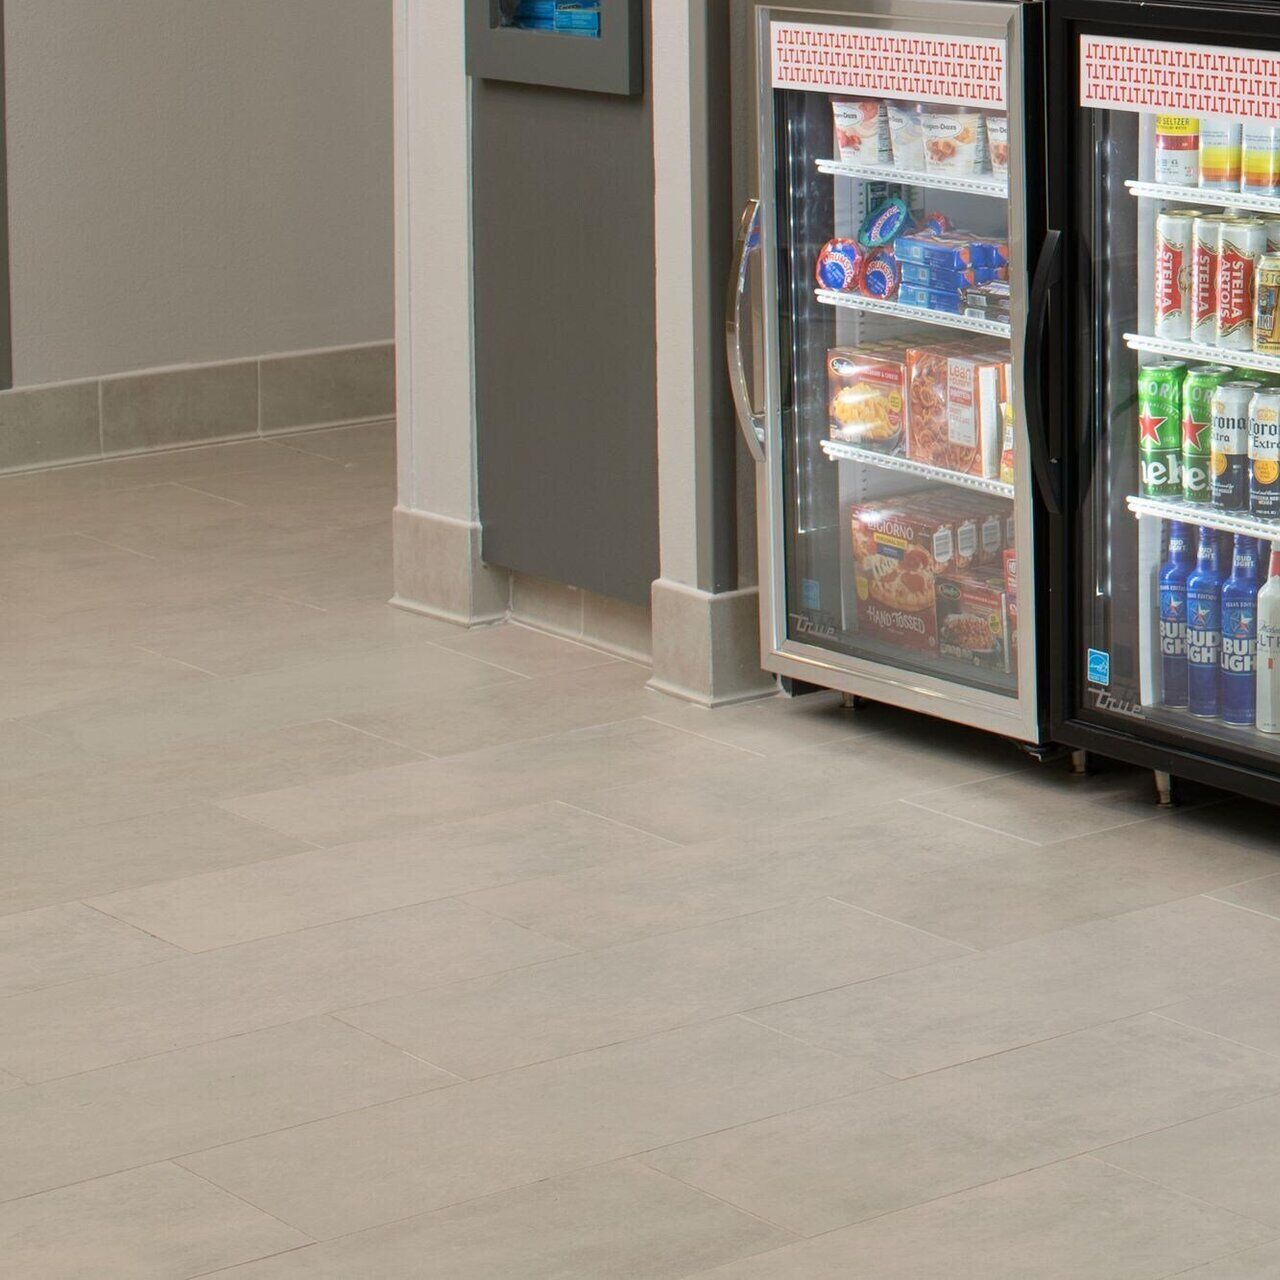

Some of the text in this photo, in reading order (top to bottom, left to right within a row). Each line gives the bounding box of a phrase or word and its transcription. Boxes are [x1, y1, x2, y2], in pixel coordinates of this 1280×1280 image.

[1162, 117, 1190, 126] SELTZER
[1162, 251, 1174, 308] STELLA
[1199, 255, 1210, 311] STELLA
[1220, 258, 1231, 319] ARTOIS
[1231, 260, 1244, 318] STELLA
